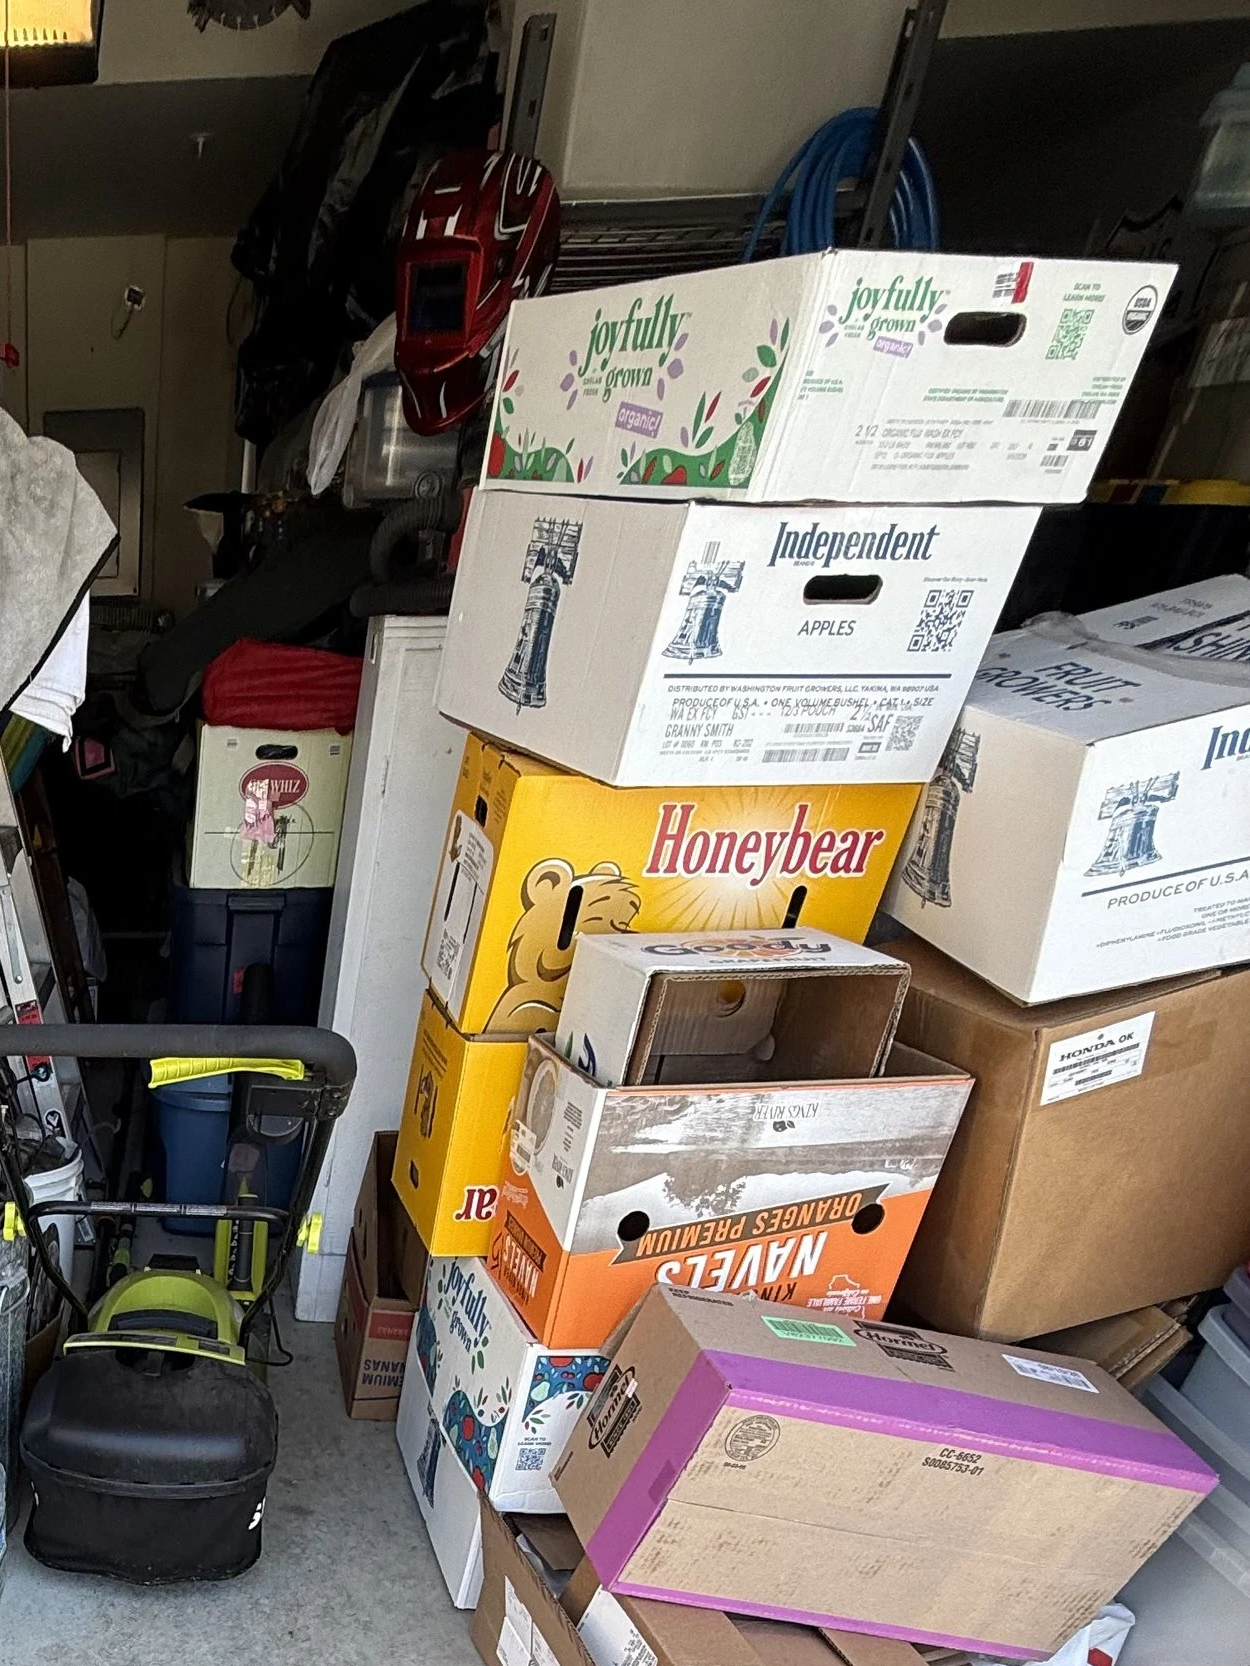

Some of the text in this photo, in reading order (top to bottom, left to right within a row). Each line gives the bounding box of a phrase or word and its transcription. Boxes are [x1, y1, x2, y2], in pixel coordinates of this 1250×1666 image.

[839, 275, 946, 324] joyfully
[578, 293, 686, 377] joyfully
[866, 314, 917, 341] grown
[602, 366, 654, 403] grown
[617, 406, 662, 438] organic!
[767, 521, 941, 569] Independent
[798, 619, 857, 637] APPLES
[667, 685, 718, 693] DISTRIBUTED
[719, 685, 730, 693] BY
[730, 685, 781, 693] WASHINGTON
[782, 685, 803, 693] FRUIT
[925, 684, 939, 693] USA
[976, 667, 1112, 711] GROWERS
[1034, 661, 1142, 693] FRUIT
[672, 698, 719, 709] PRODUCE
[719, 698, 733, 708] OF
[771, 698, 792, 708] ONE
[794, 698, 834, 708] VOLUME
[834, 698, 870, 708] BUSHEL
[913, 698, 933, 708] SIZE
[800, 705, 836, 717] POUCH
[664, 723, 735, 738] GRANNY SMITH
[866, 714, 895, 733] SAF
[270, 779, 301, 794] WHIZ
[644, 803, 886, 889] Honeybear
[1107, 882, 1183, 910] PRODUCE
[1185, 877, 1207, 893] OF
[642, 940, 833, 957] Goody
[1059, 1031, 1135, 1063] HONDA OK
[754, 1102, 819, 1120] KINGS RIVER
[636, 1192, 863, 1258] ORANGES PREMIUM
[502, 1232, 540, 1299] NAVELS
[656, 1231, 828, 1292] NAVELS
[444, 1258, 491, 1349] joyfully
[668, 1287, 690, 1295] KEEP
[671, 1292, 734, 1307] REFRIGERATED
[450, 1309, 472, 1353] grown
[865, 1331, 936, 1351] Hormel
[593, 1376, 631, 1443] Hormel
[922, 1457, 985, 1477] S0085753-01
[939, 1448, 982, 1464] CC-6652
